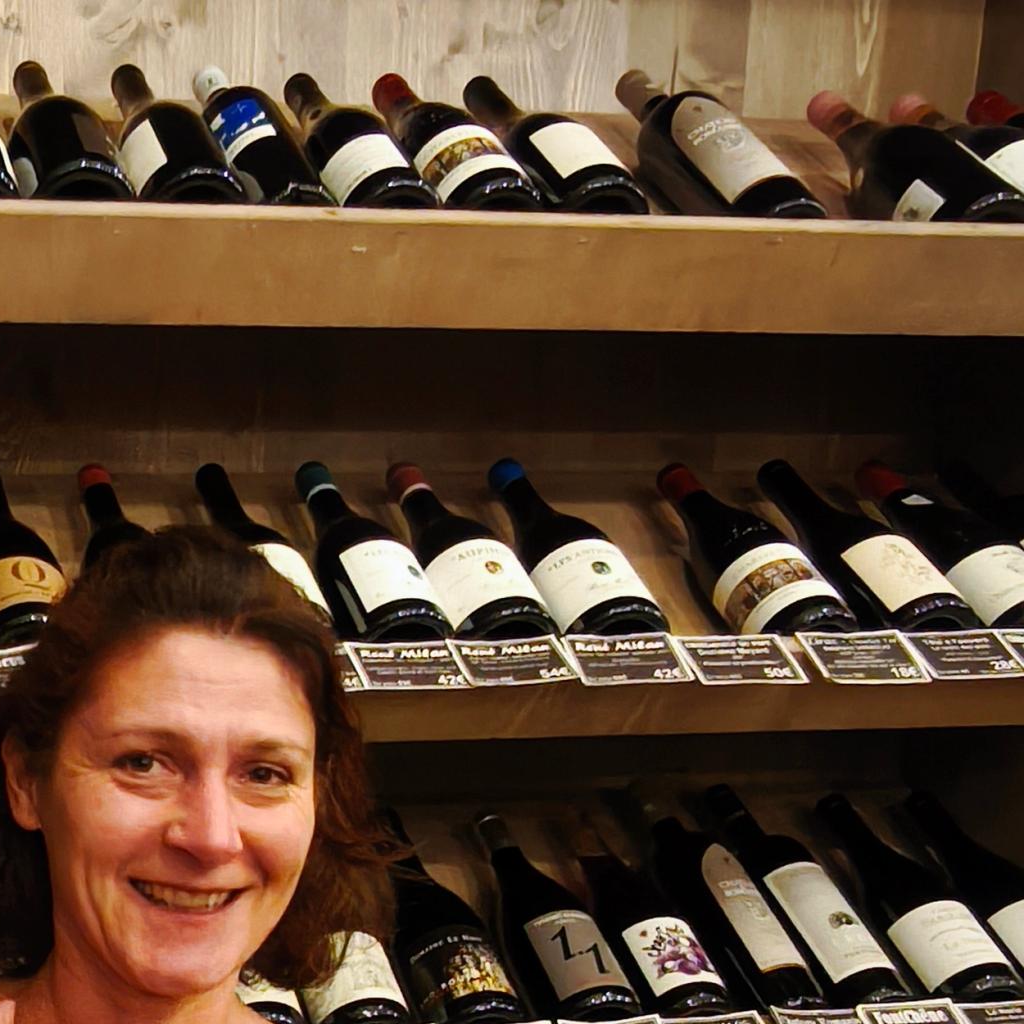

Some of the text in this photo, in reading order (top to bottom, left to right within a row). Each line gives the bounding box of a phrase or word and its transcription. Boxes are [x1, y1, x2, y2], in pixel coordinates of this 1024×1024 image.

[501, 644, 550, 656] Milan
[615, 640, 664, 652] Milan
[652, 667, 682, 679] 42€
[763, 667, 794, 678] 50€
